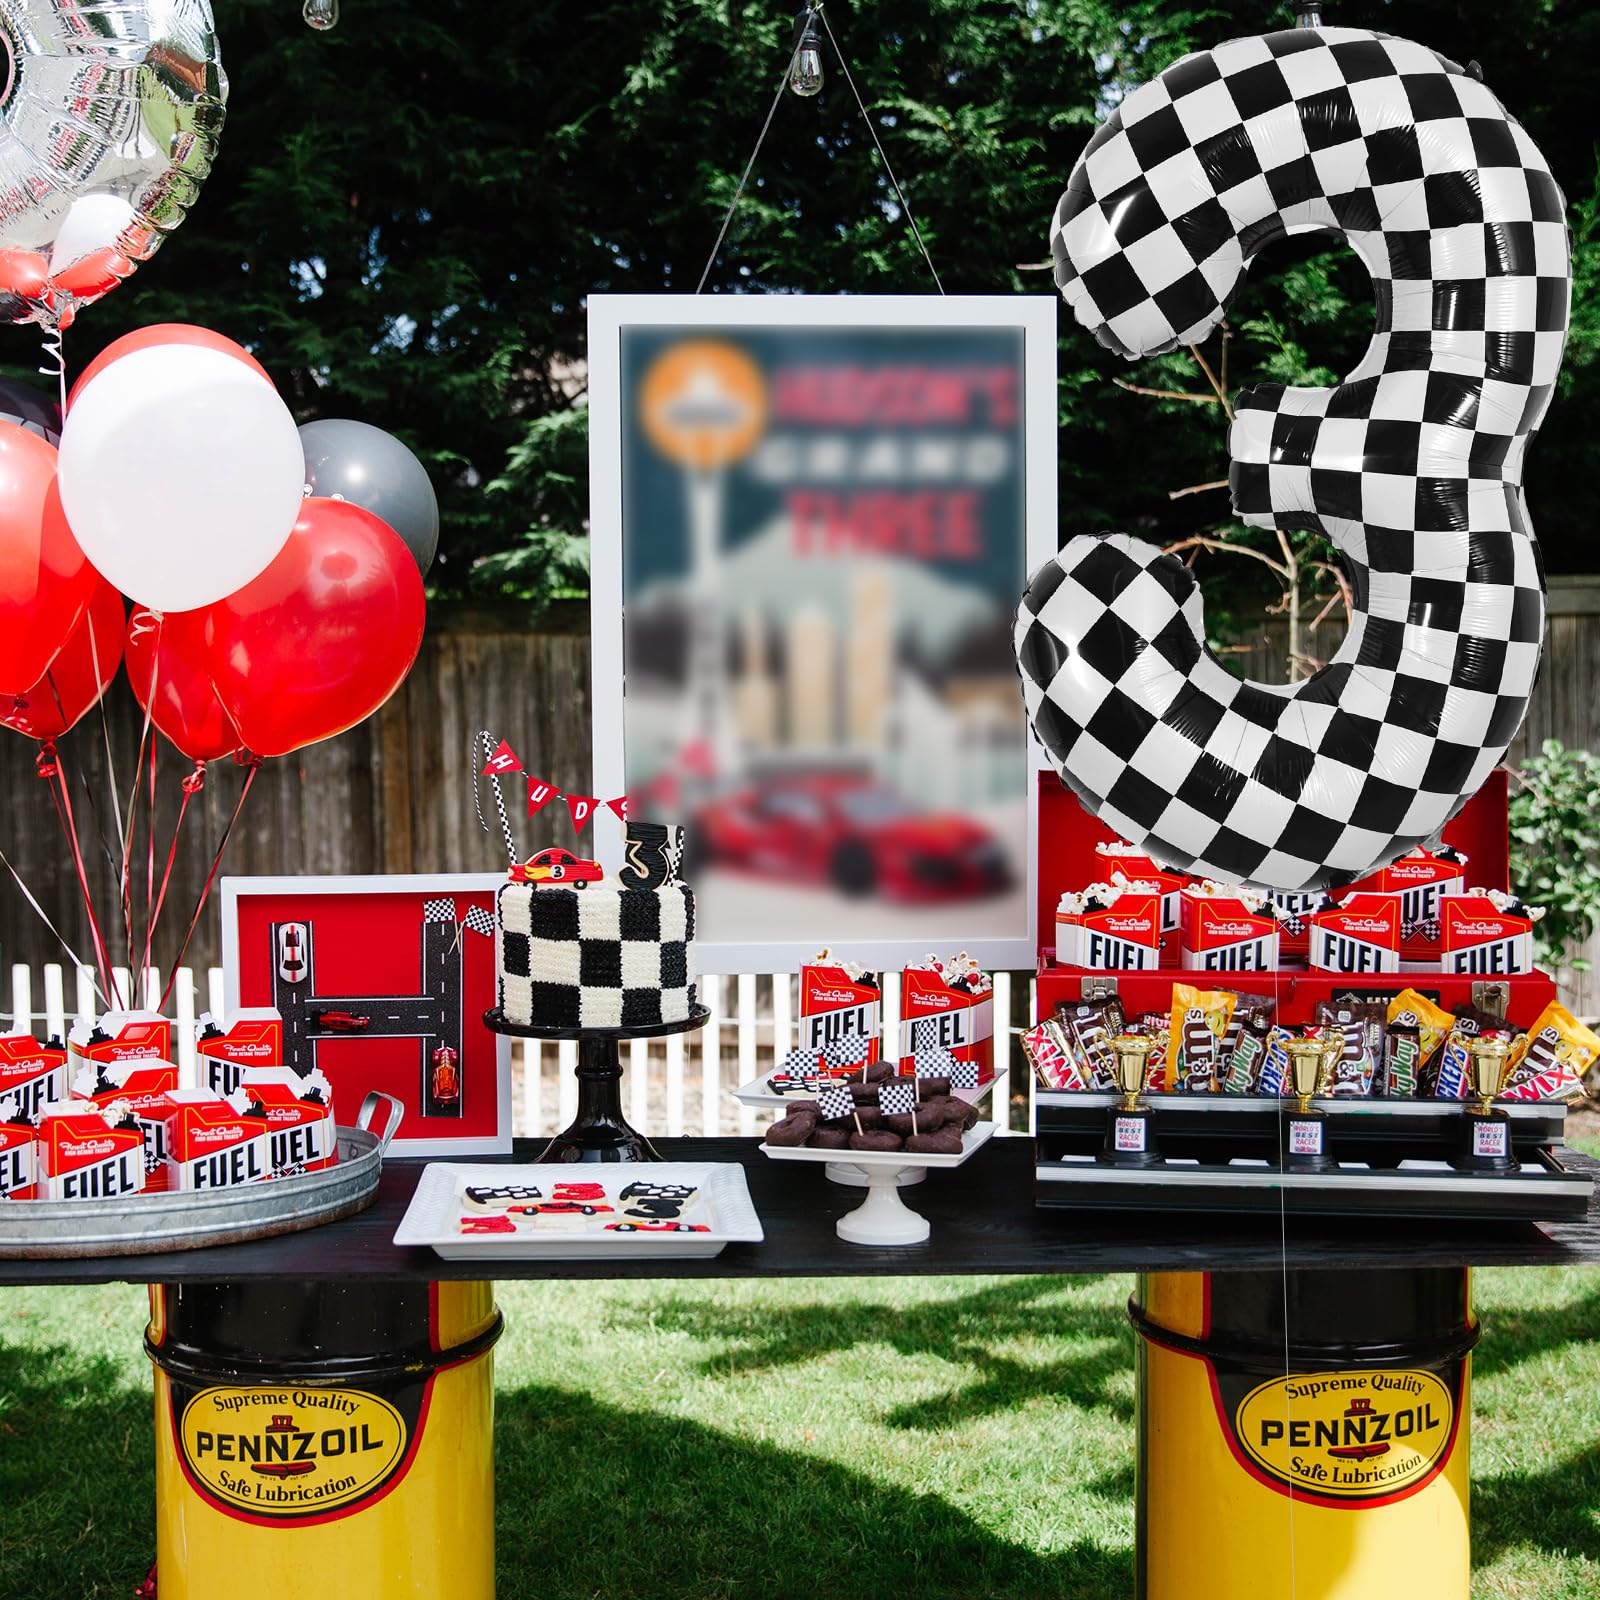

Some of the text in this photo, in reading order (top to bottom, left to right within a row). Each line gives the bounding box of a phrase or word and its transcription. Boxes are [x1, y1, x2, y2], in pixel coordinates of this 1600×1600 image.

[553, 865, 564, 878] 3
[1388, 865, 1436, 877] Finest Quality
[1105, 917, 1152, 929] Finest Quality
[1203, 921, 1253, 935] Finest Quality
[1340, 917, 1390, 932] Finest Quality
[1452, 921, 1503, 934] Finest Quality
[1205, 940, 1267, 971] FUEL
[1455, 940, 1521, 974] FUEL
[810, 988, 855, 1001] Finest Quality
[910, 991, 951, 1006] Finest Quality
[811, 1007, 869, 1048] FUEL
[112, 1046, 160, 1056] Finest Quality
[224, 1043, 272, 1055] Finest Quality
[21, 1058, 45, 1069] Quality
[275, 1108, 301, 1120] Quality
[190, 1126, 244, 1138] Finest Quality
[1120, 1133, 1139, 1141] RACER
[60, 1139, 116, 1152] Finest Quality
[271, 1126, 320, 1167] UEL
[193, 1143, 261, 1189] FUEL
[64, 1156, 134, 1199] FUEL
[1285, 1374, 1426, 1399] Supreme Quality
[212, 1390, 360, 1416] Supreme Quality
[1261, 1403, 1440, 1448] PENNZOIL
[196, 1424, 384, 1463] PENNZOIL
[1290, 1453, 1422, 1484] Safe Lubrication
[218, 1470, 358, 1502] Safe Lubrication
